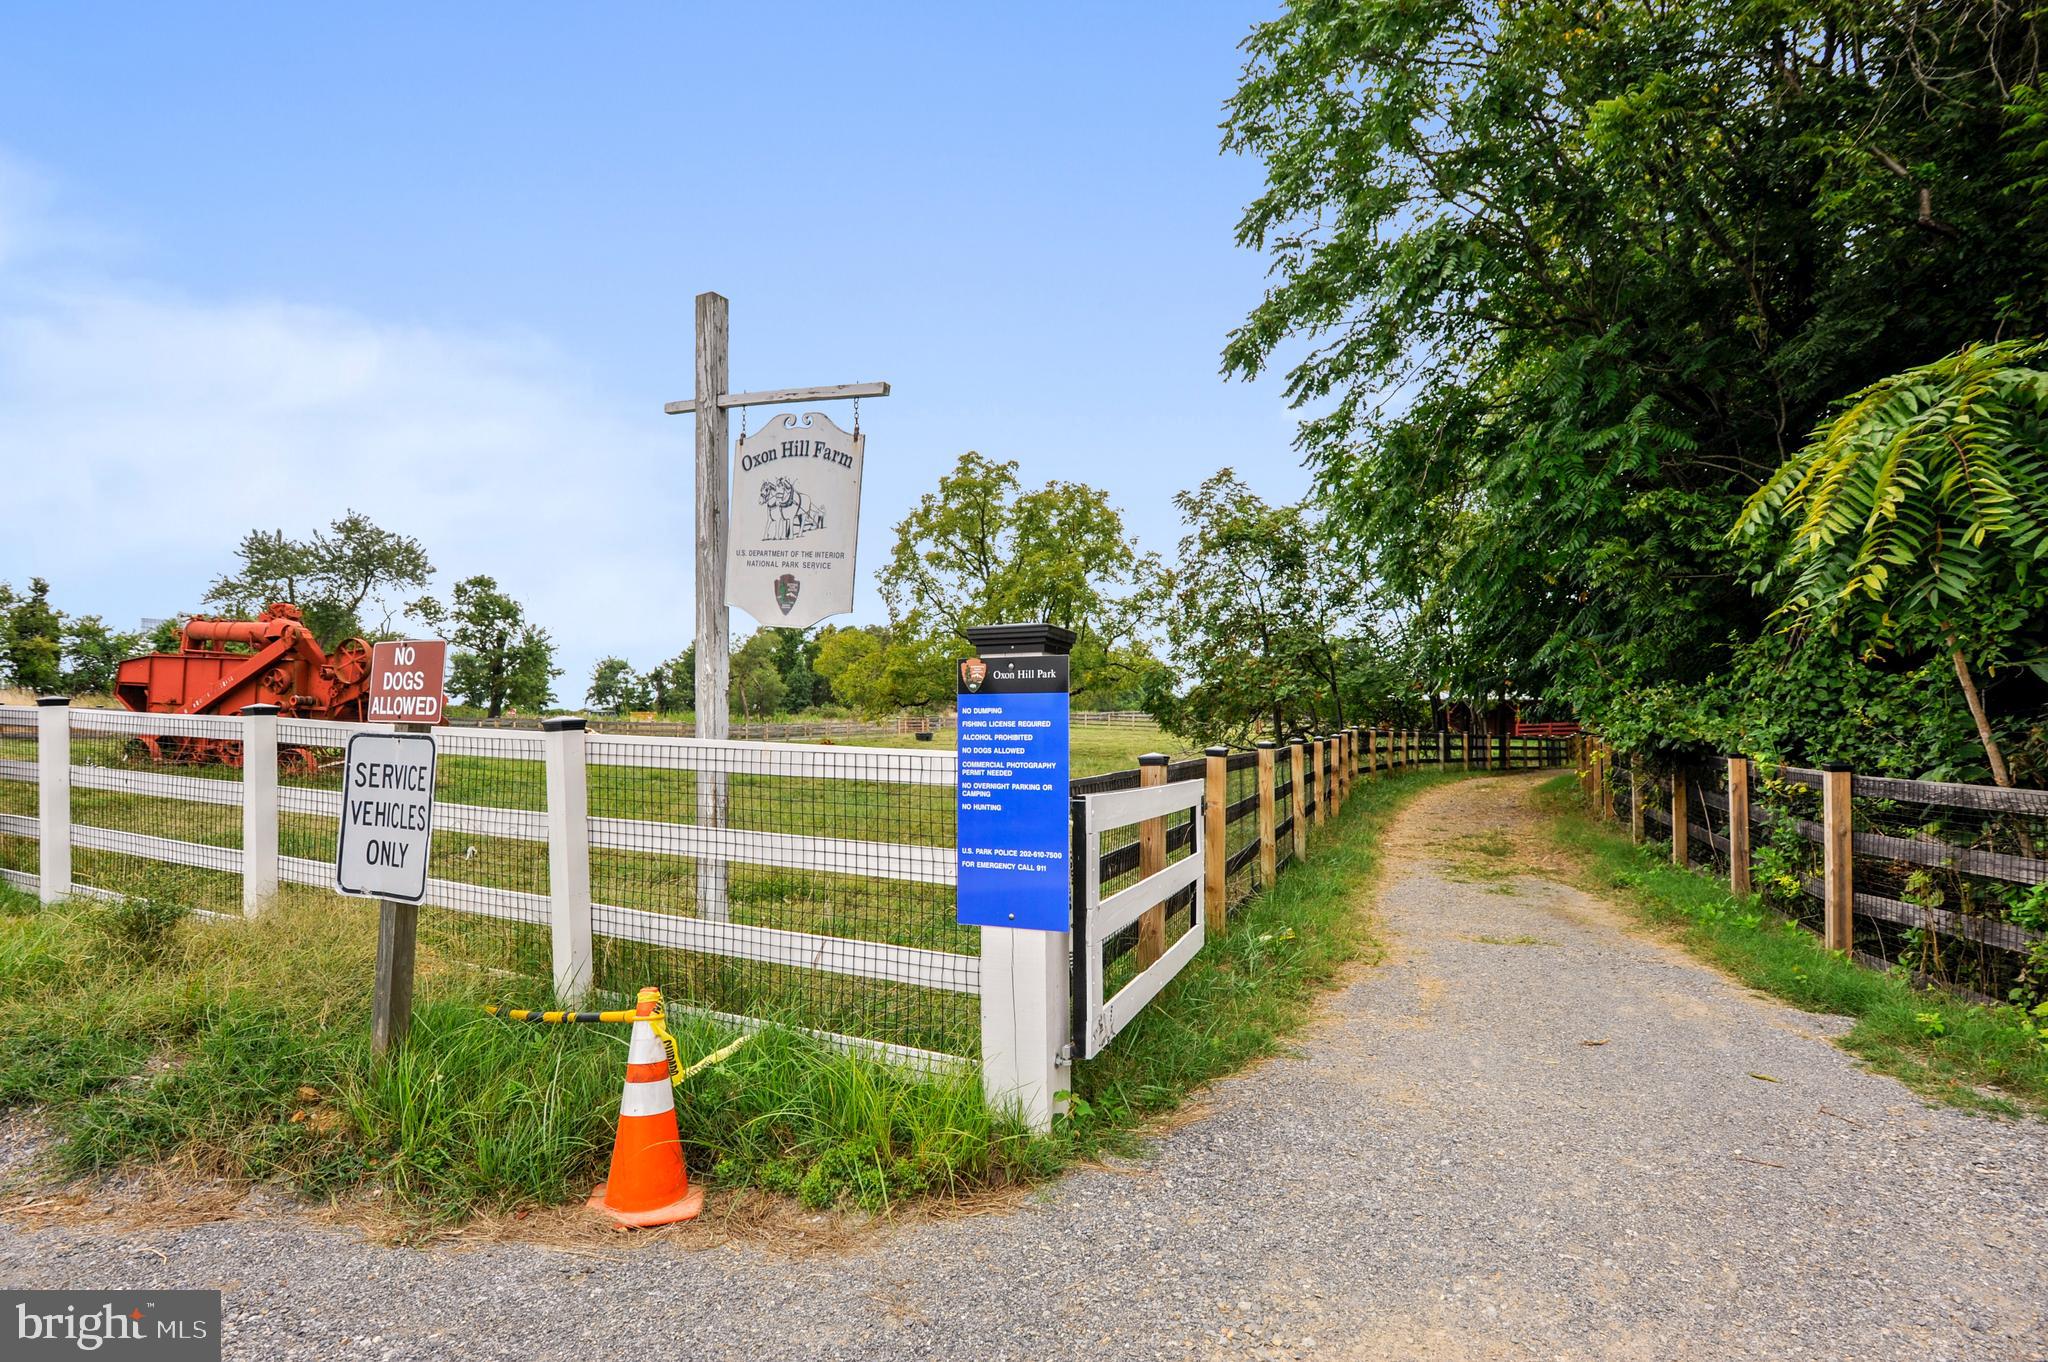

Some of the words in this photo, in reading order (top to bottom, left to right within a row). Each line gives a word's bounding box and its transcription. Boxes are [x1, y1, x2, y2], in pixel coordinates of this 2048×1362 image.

[742, 448, 778, 471] Oxon
[781, 440, 810, 458] Hill
[813, 441, 853, 469] Farm
[746, 560, 779, 568] NATIONAL
[803, 561, 832, 570] SERVICE
[815, 551, 845, 559] INTERIOR
[394, 646, 416, 666] NO
[383, 671, 424, 691] DOGS
[993, 670, 1015, 680] Oxon
[1018, 669, 1035, 679] Hill
[1037, 669, 1057, 679] Park
[371, 695, 438, 716] ALLOWED
[354, 762, 428, 792] SERVICE
[1012, 783, 1041, 791] PARKING
[351, 800, 426, 831] VEHICLES
[366, 839, 409, 868] ONLY
[994, 849, 1018, 857] POLICE
[977, 861, 1016, 870] EMERGENCY
[1036, 864, 1047, 872] 911
